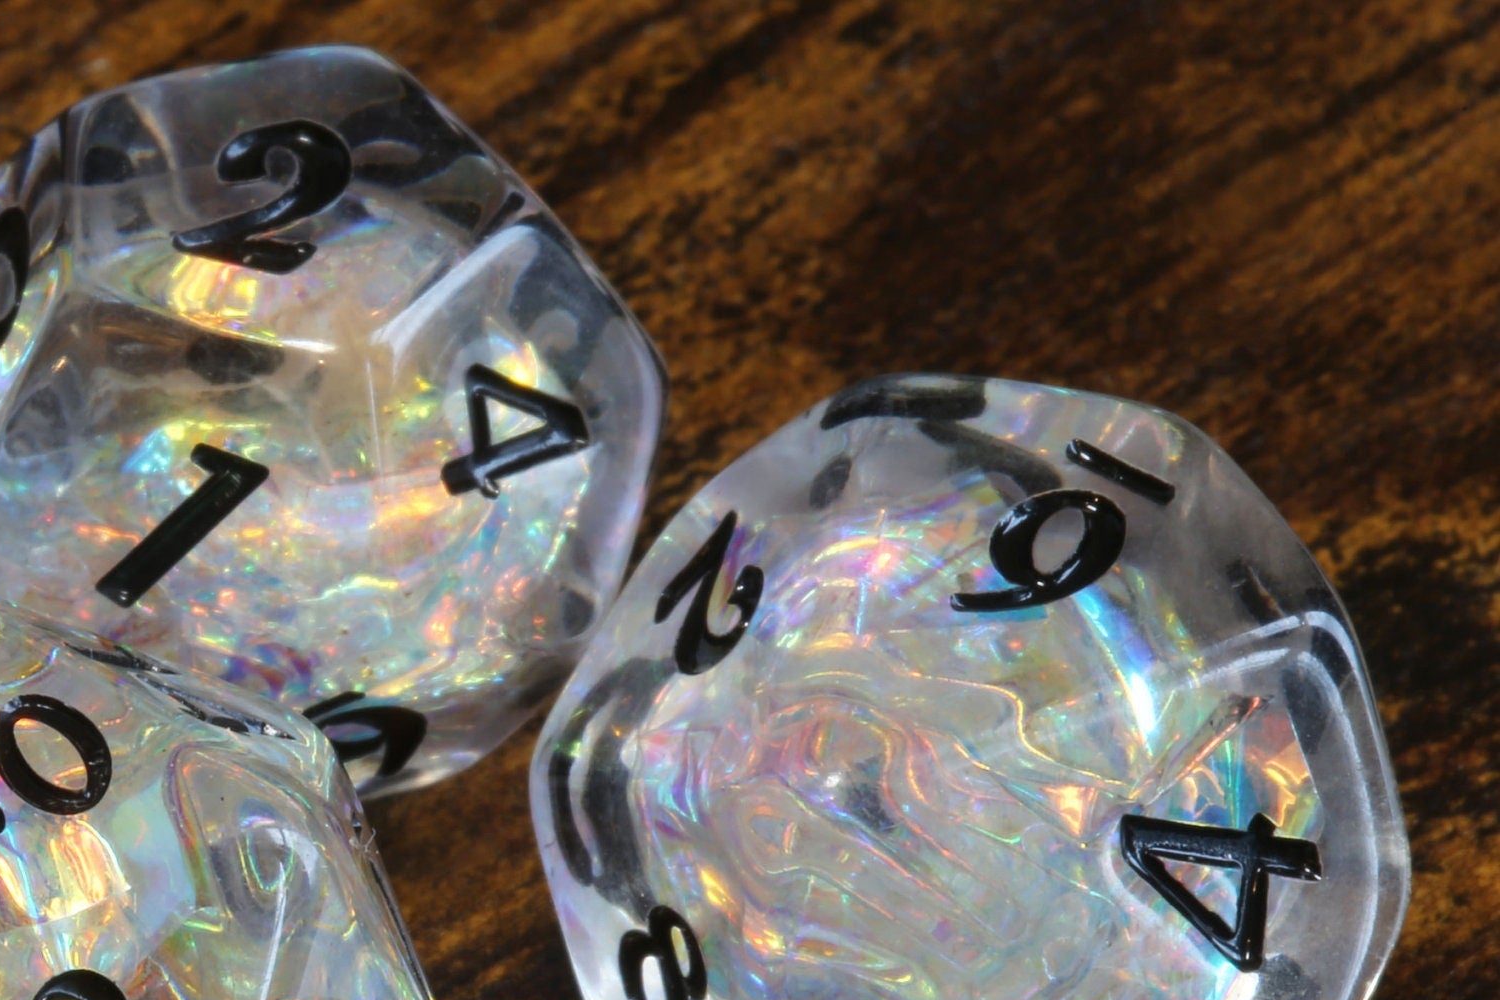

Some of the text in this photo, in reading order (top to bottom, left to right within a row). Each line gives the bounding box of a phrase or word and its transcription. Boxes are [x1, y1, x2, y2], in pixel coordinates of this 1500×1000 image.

[172, 120, 351, 274] 2
[441, 365, 588, 499] 4
[96, 443, 269, 608] 1
[654, 510, 764, 676] 2
[951, 490, 1126, 611] 6
[1119, 812, 1323, 972] 4
